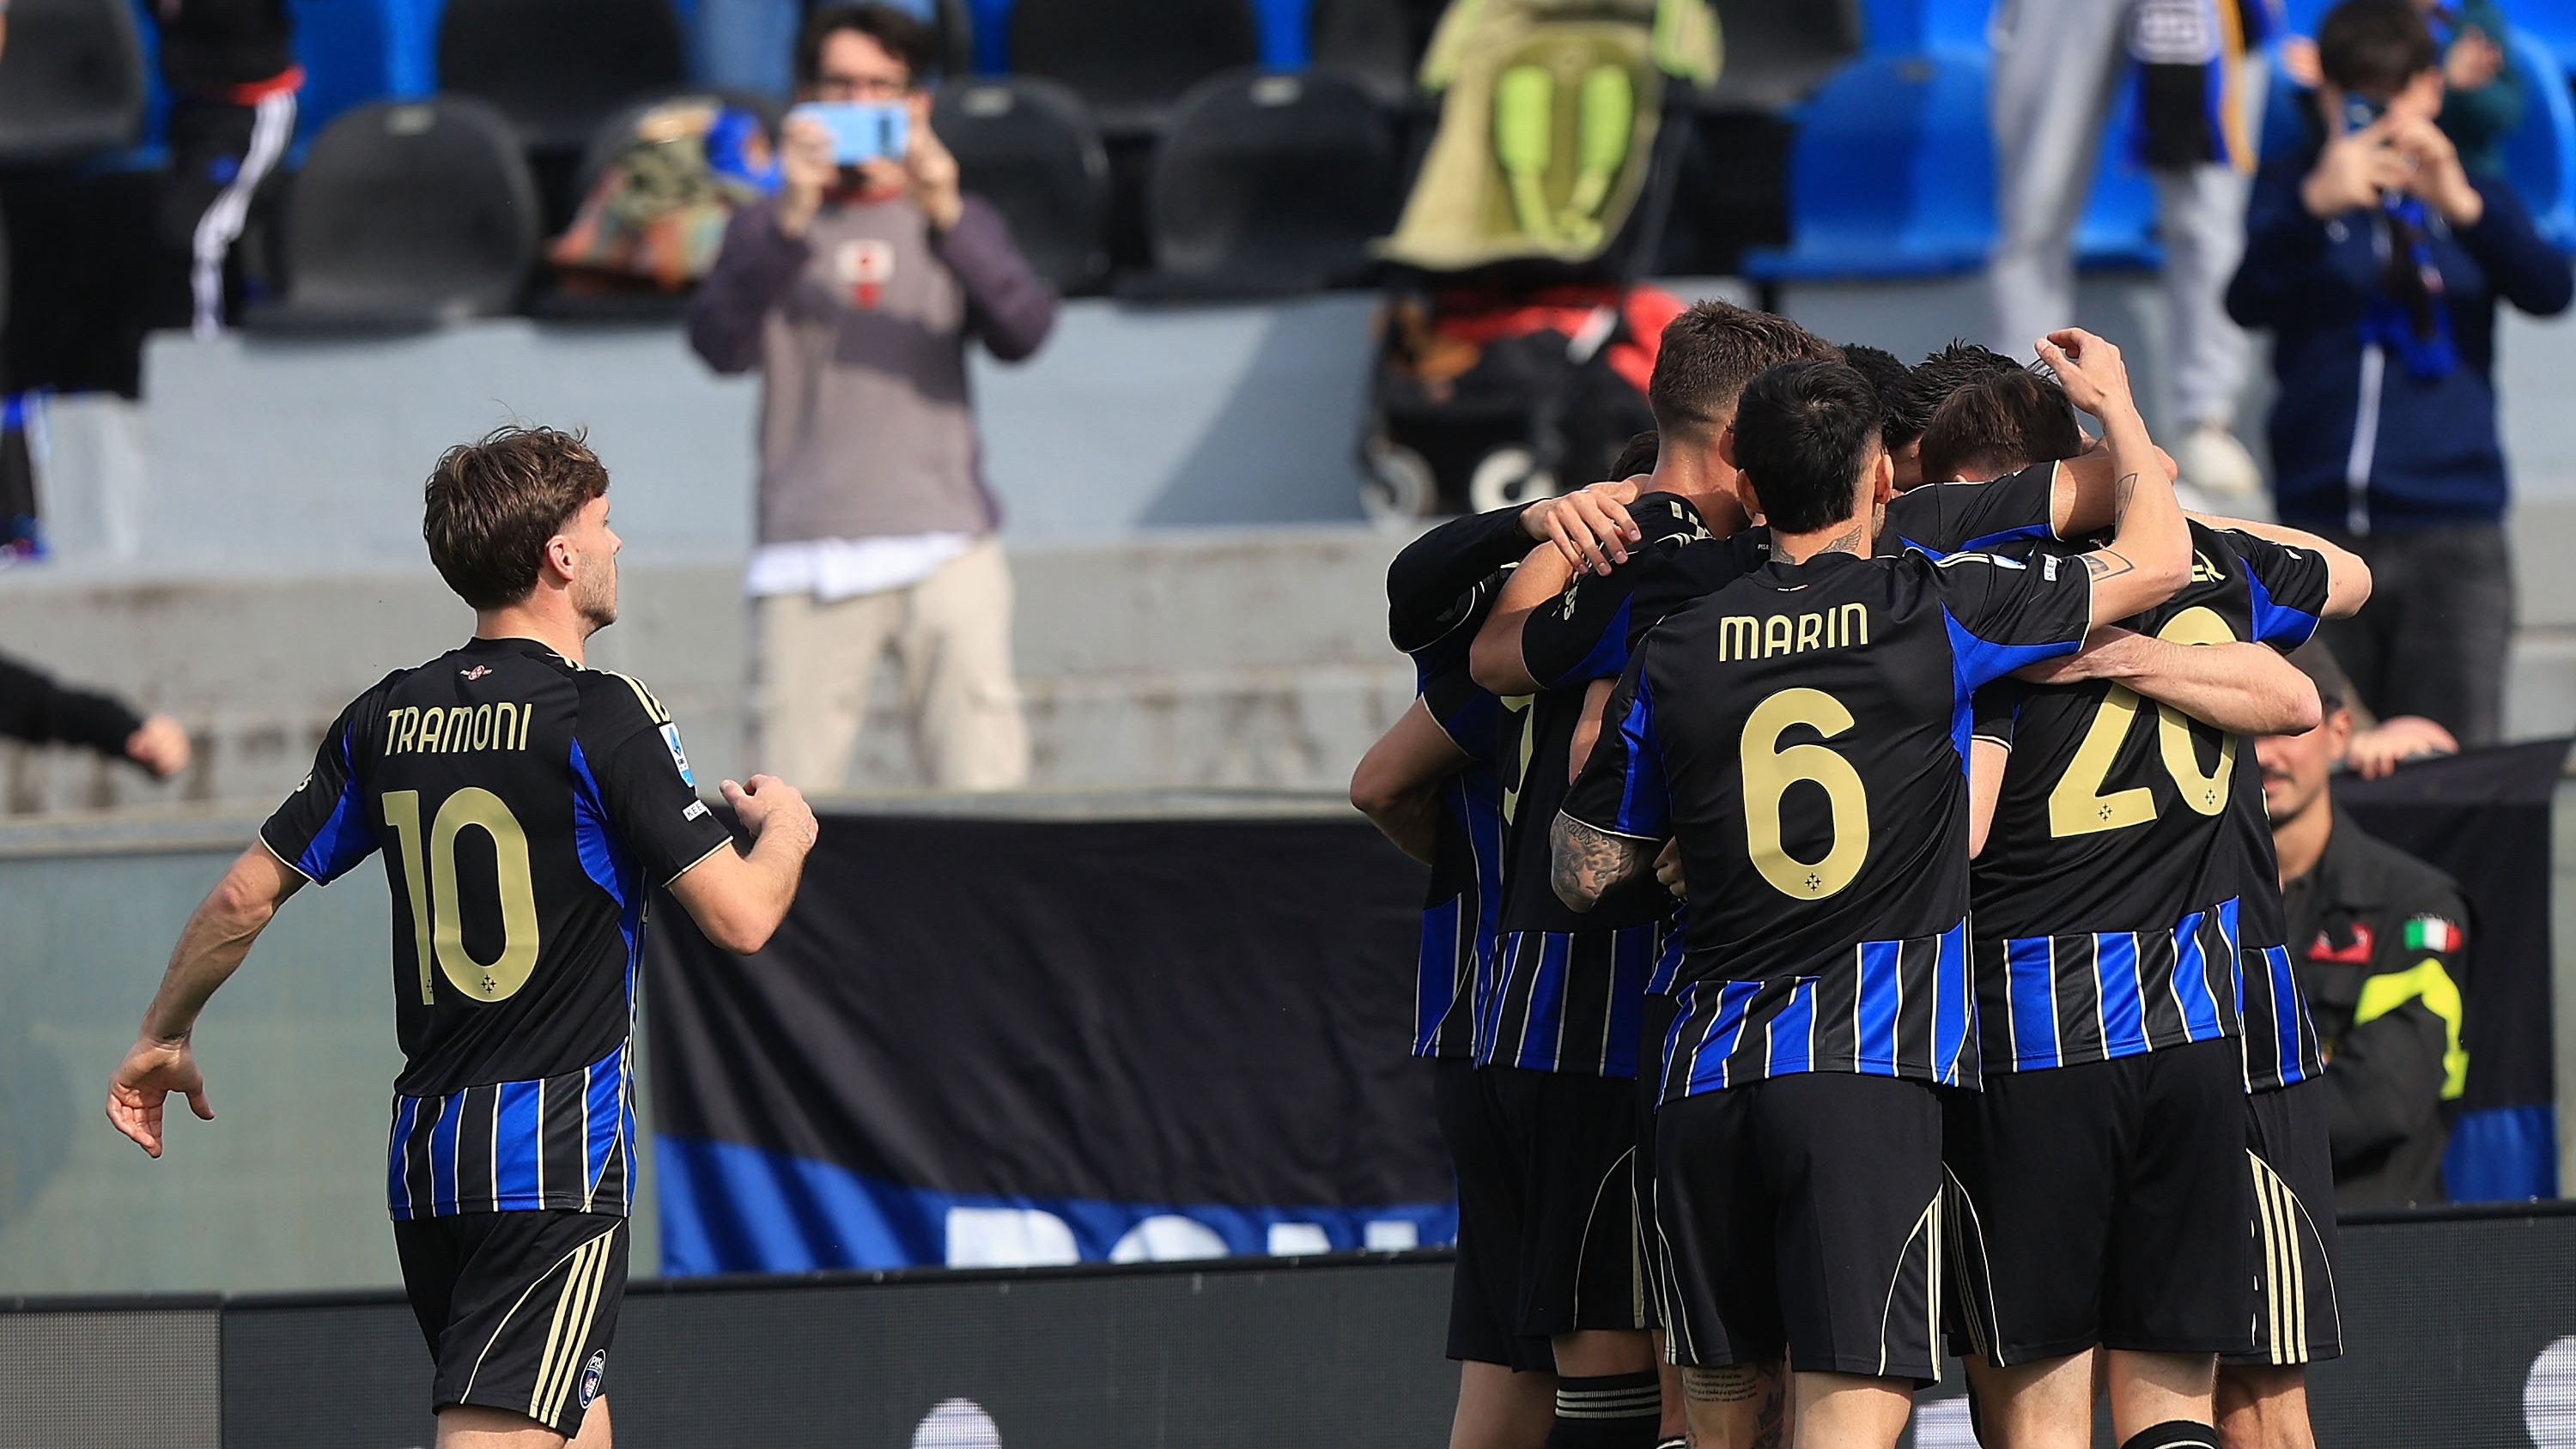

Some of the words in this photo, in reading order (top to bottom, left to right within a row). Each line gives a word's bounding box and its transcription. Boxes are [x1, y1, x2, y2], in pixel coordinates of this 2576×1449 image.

[385, 702, 532, 756] TRAMONI
[1719, 603, 1868, 662] MARIN
[2048, 606, 2238, 838] 20
[381, 787, 540, 1005] 10
[1741, 688, 1870, 900] 6
